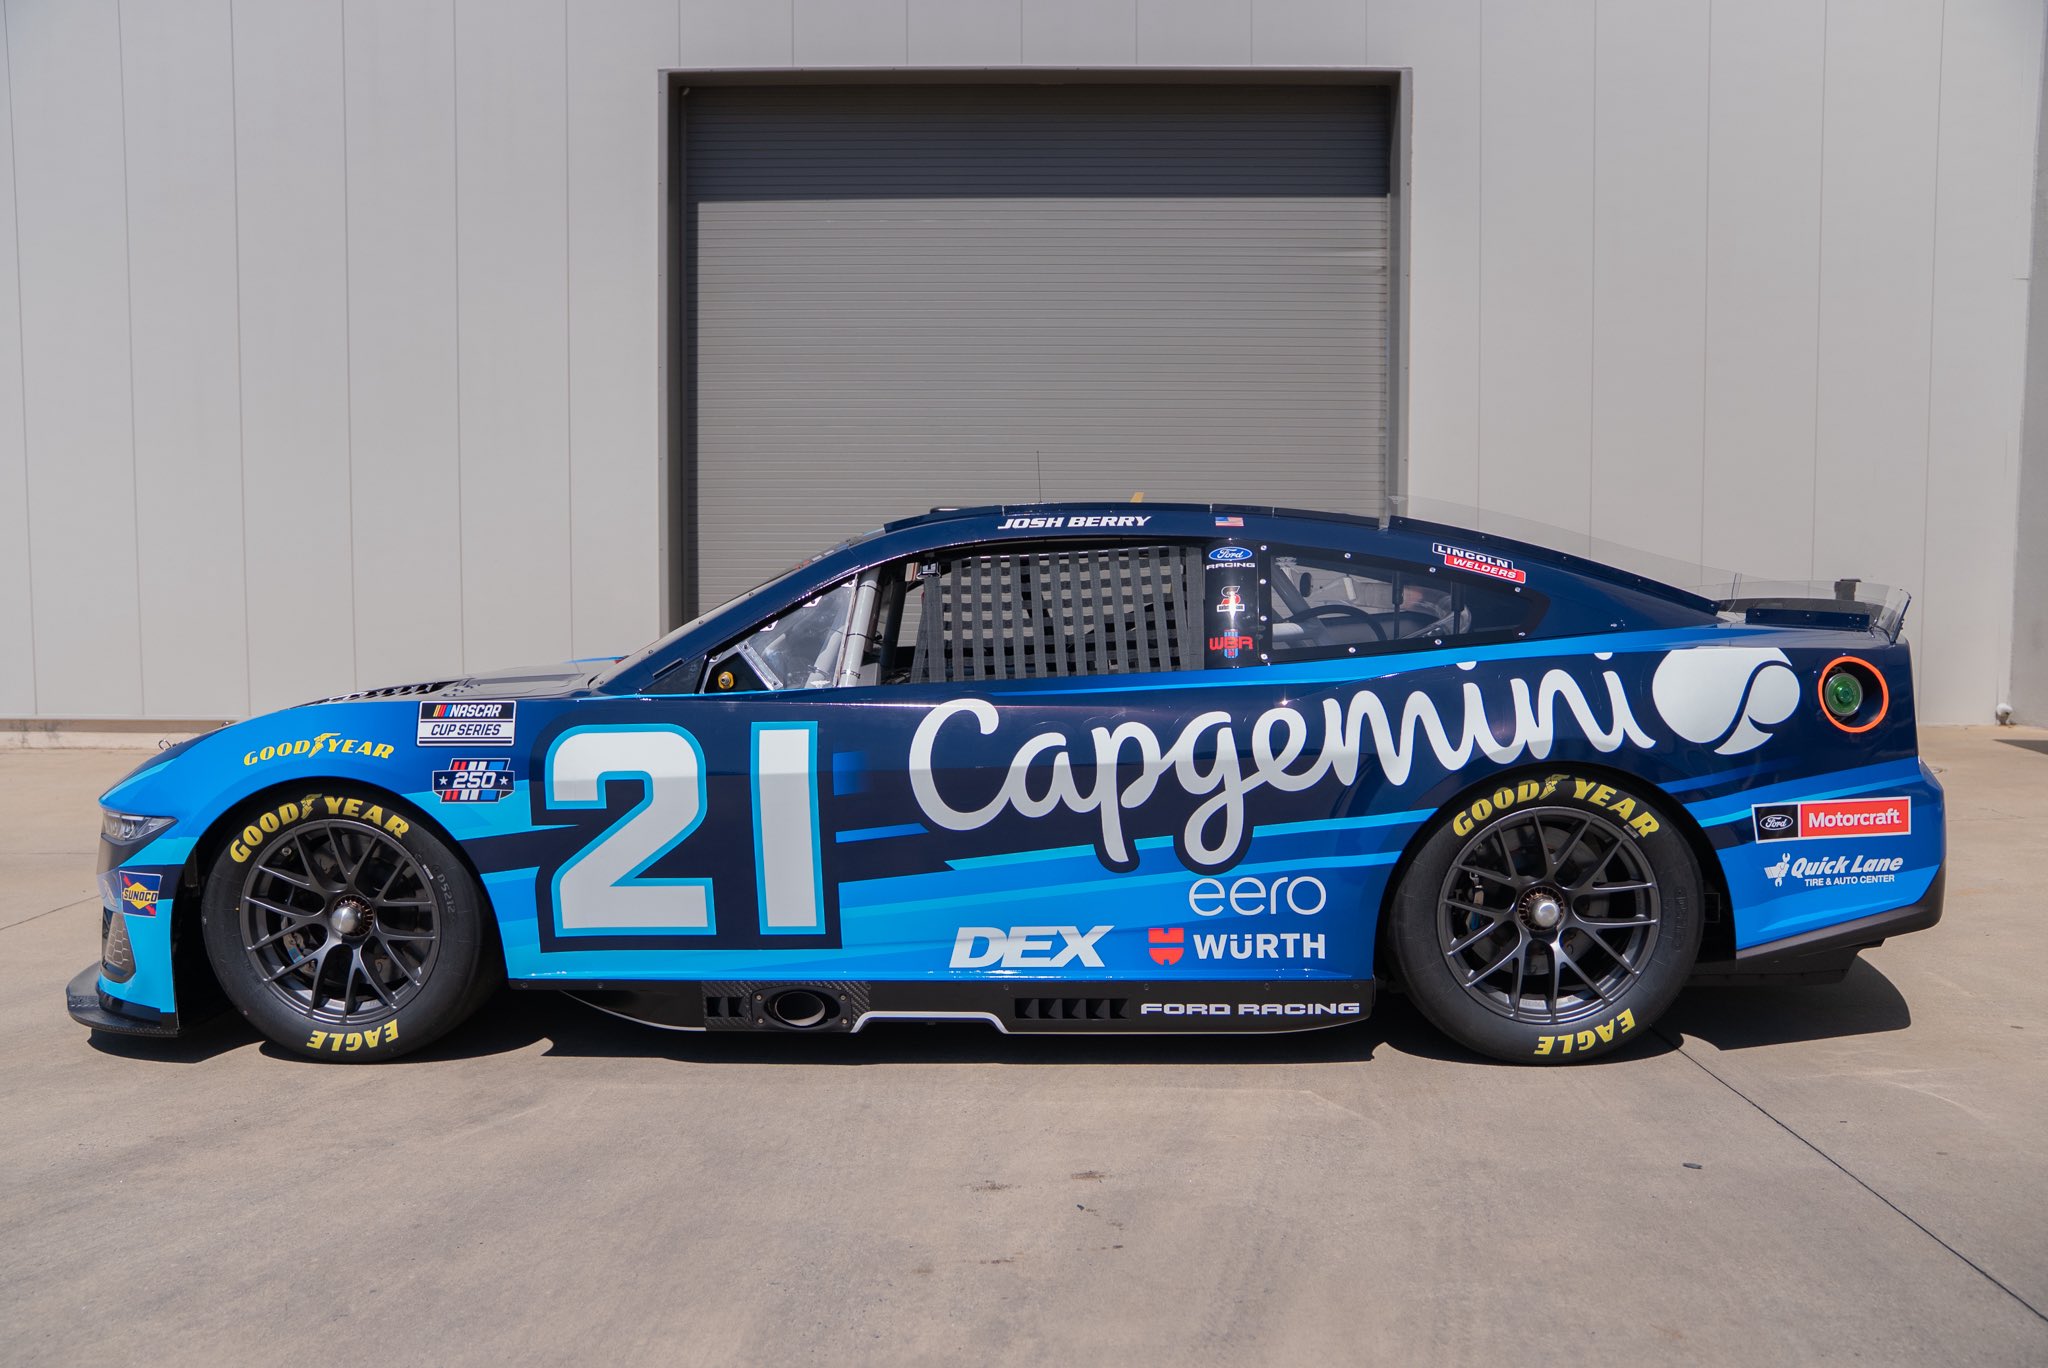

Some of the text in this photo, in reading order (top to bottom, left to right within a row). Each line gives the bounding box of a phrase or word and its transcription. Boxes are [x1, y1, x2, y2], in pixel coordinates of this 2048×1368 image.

[997, 515, 1152, 530] JOSH BERRY
[1217, 549, 1244, 559] Ford
[1437, 545, 1509, 568] LINCOLN
[1206, 562, 1256, 570] RACING
[1453, 557, 1517, 579] WELDERS
[1209, 635, 1254, 651] WBR
[448, 704, 502, 718] NASCAR
[431, 723, 502, 736] CUP SERIES
[908, 650, 1657, 866] Capgemini
[452, 771, 497, 789] 250
[1765, 807, 1901, 828] Ford Motorcraft
[545, 721, 826, 937] 21
[1791, 855, 1904, 879] Quick Lane
[1805, 874, 1895, 887] TIRE & AUTO CENTER
[124, 889, 158, 902] SUNOCO
[1188, 876, 1327, 917] eero
[949, 925, 1115, 967] DEX
[1140, 1002, 1360, 1015] FORD RACING
[306, 1018, 399, 1052] EAGLE
[1533, 1007, 1636, 1055] EAGLE
